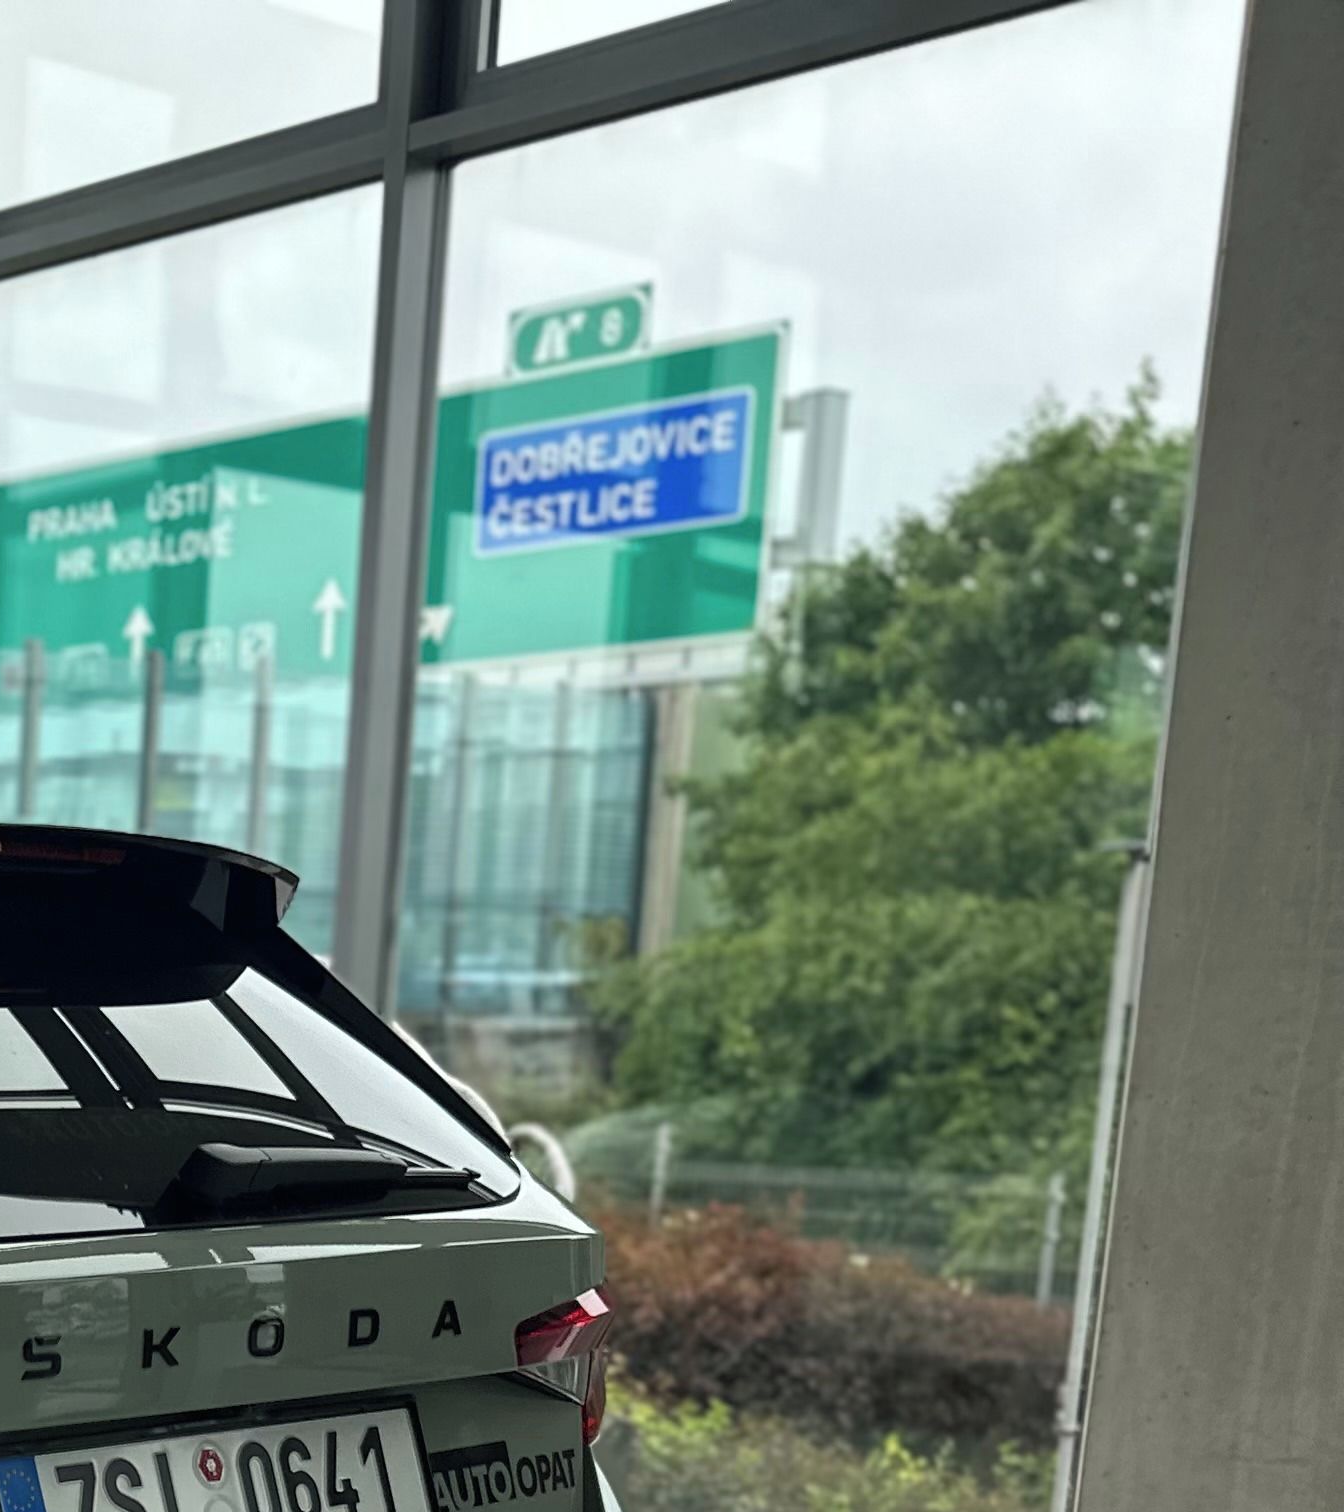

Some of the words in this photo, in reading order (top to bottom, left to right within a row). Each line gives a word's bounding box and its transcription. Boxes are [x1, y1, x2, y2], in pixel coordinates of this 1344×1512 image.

[490, 410, 737, 488] DOBŘEJOVICE
[26, 497, 118, 543] PRAHA
[487, 476, 658, 539] ČESTLICE
[107, 518, 233, 575] KRÁLOVÉ
[428, 1460, 515, 1512] AUTO
[516, 1449, 576, 1498] OPAT
